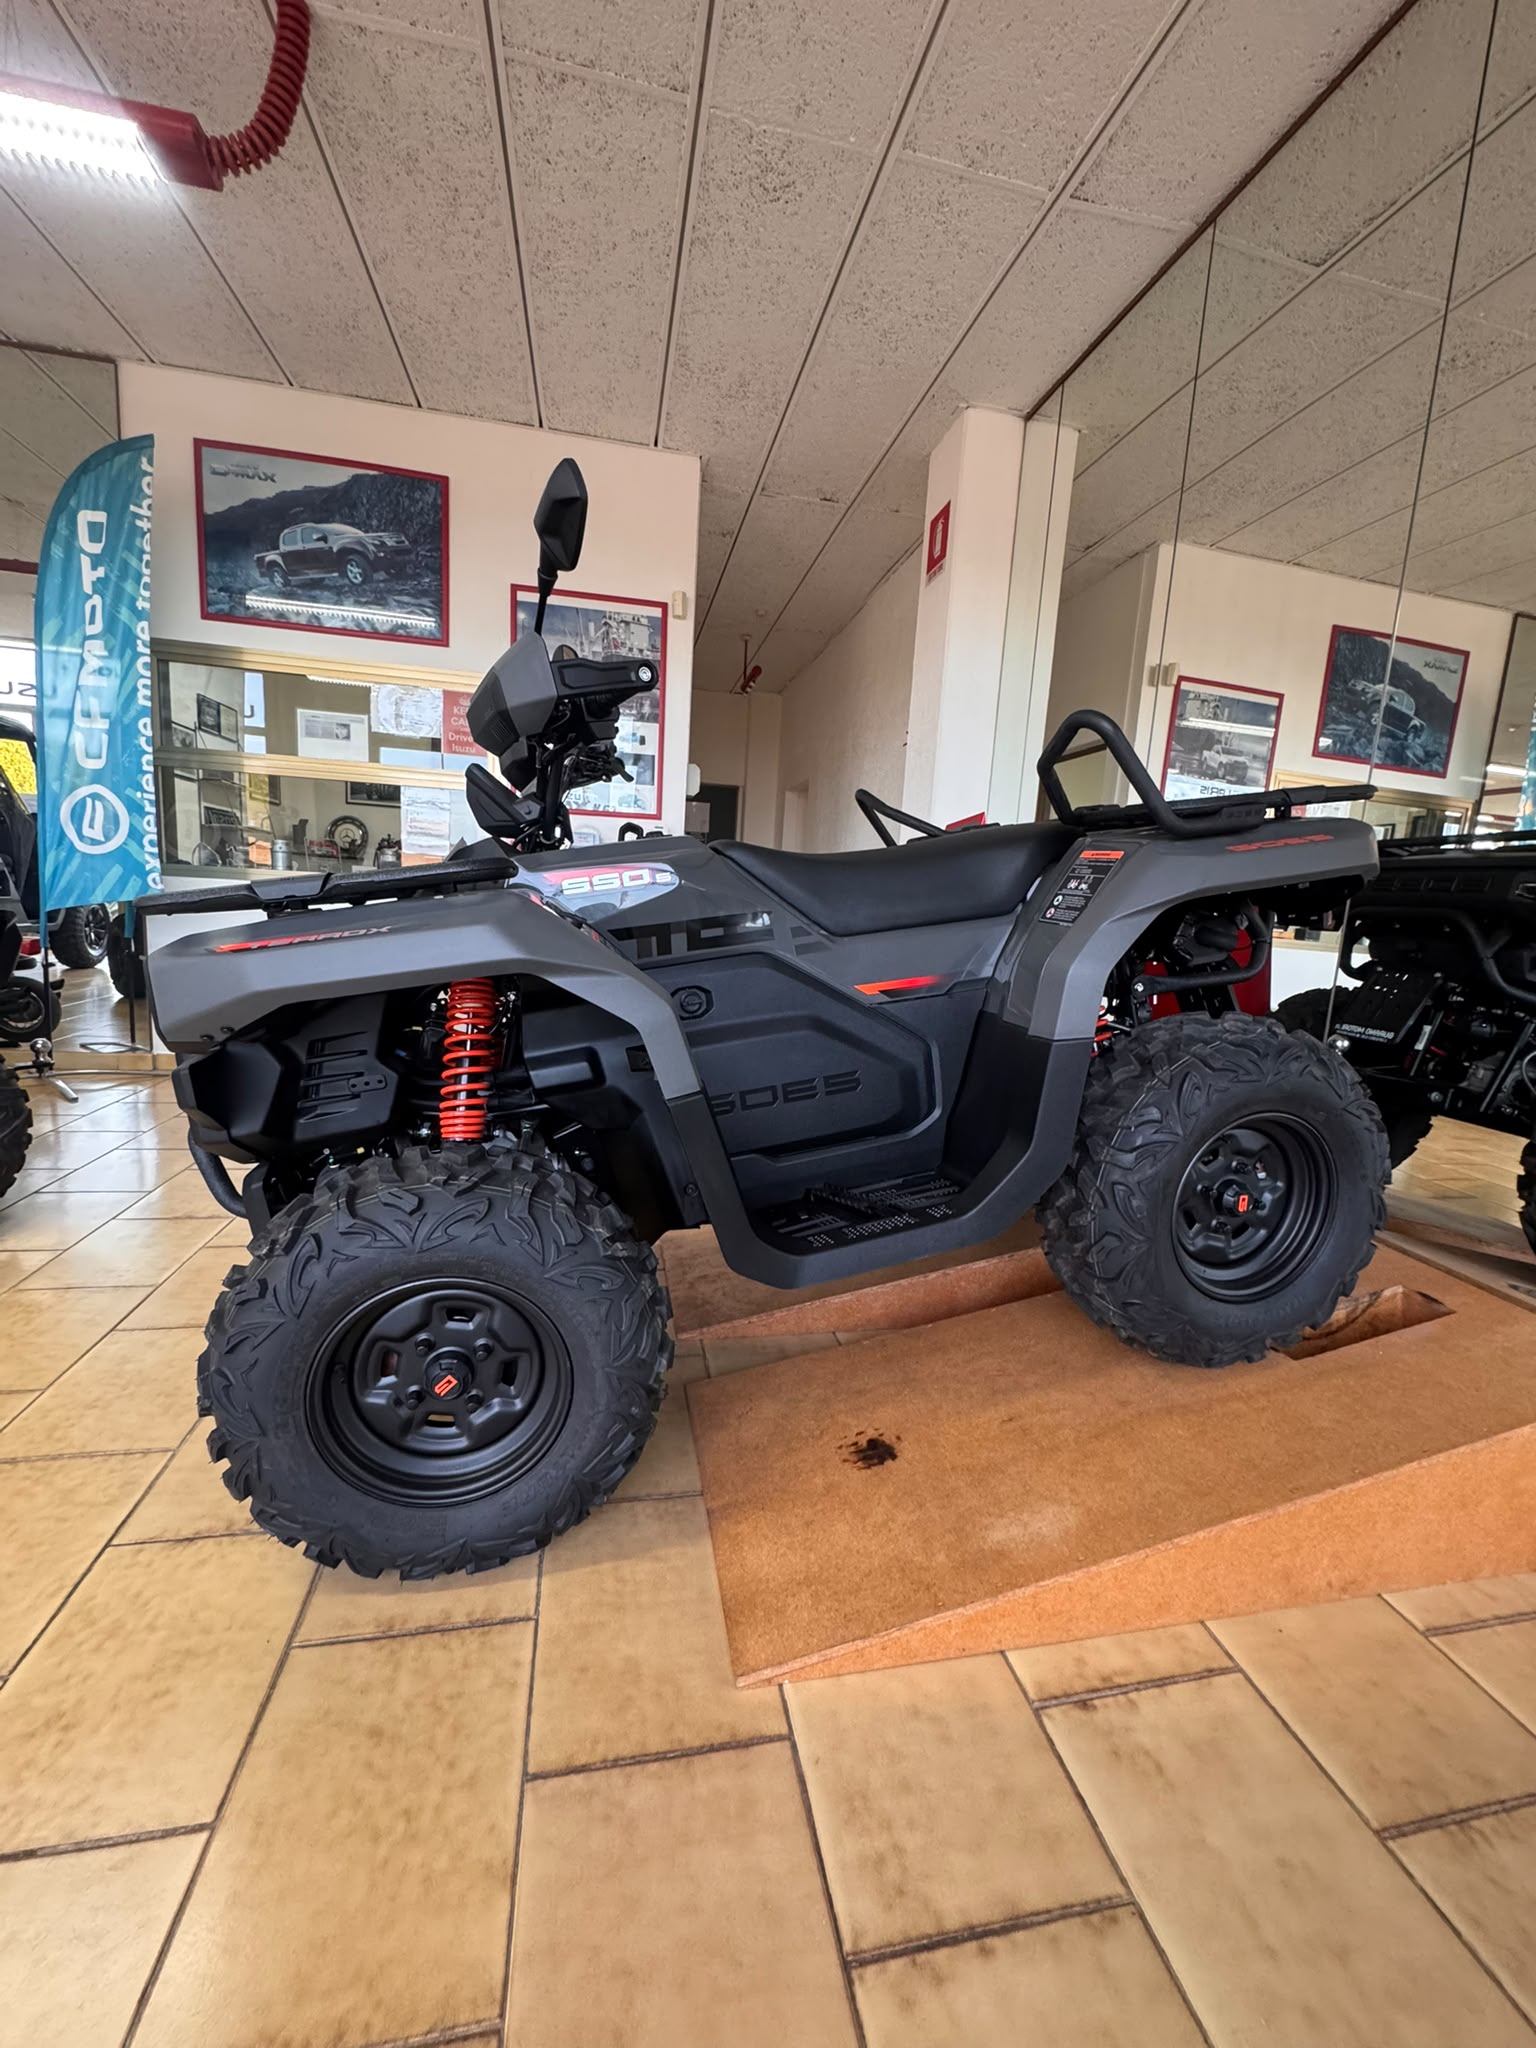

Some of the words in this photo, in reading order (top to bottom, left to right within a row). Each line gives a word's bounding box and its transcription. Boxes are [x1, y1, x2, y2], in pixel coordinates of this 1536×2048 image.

[74, 510, 109, 770] CFMOTO
[135, 620, 152, 707] more
[448, 731, 475, 743] Drive
[452, 743, 477, 754] Isuzu
[136, 717, 164, 890] experience
[250, 926, 392, 950] TERROX
